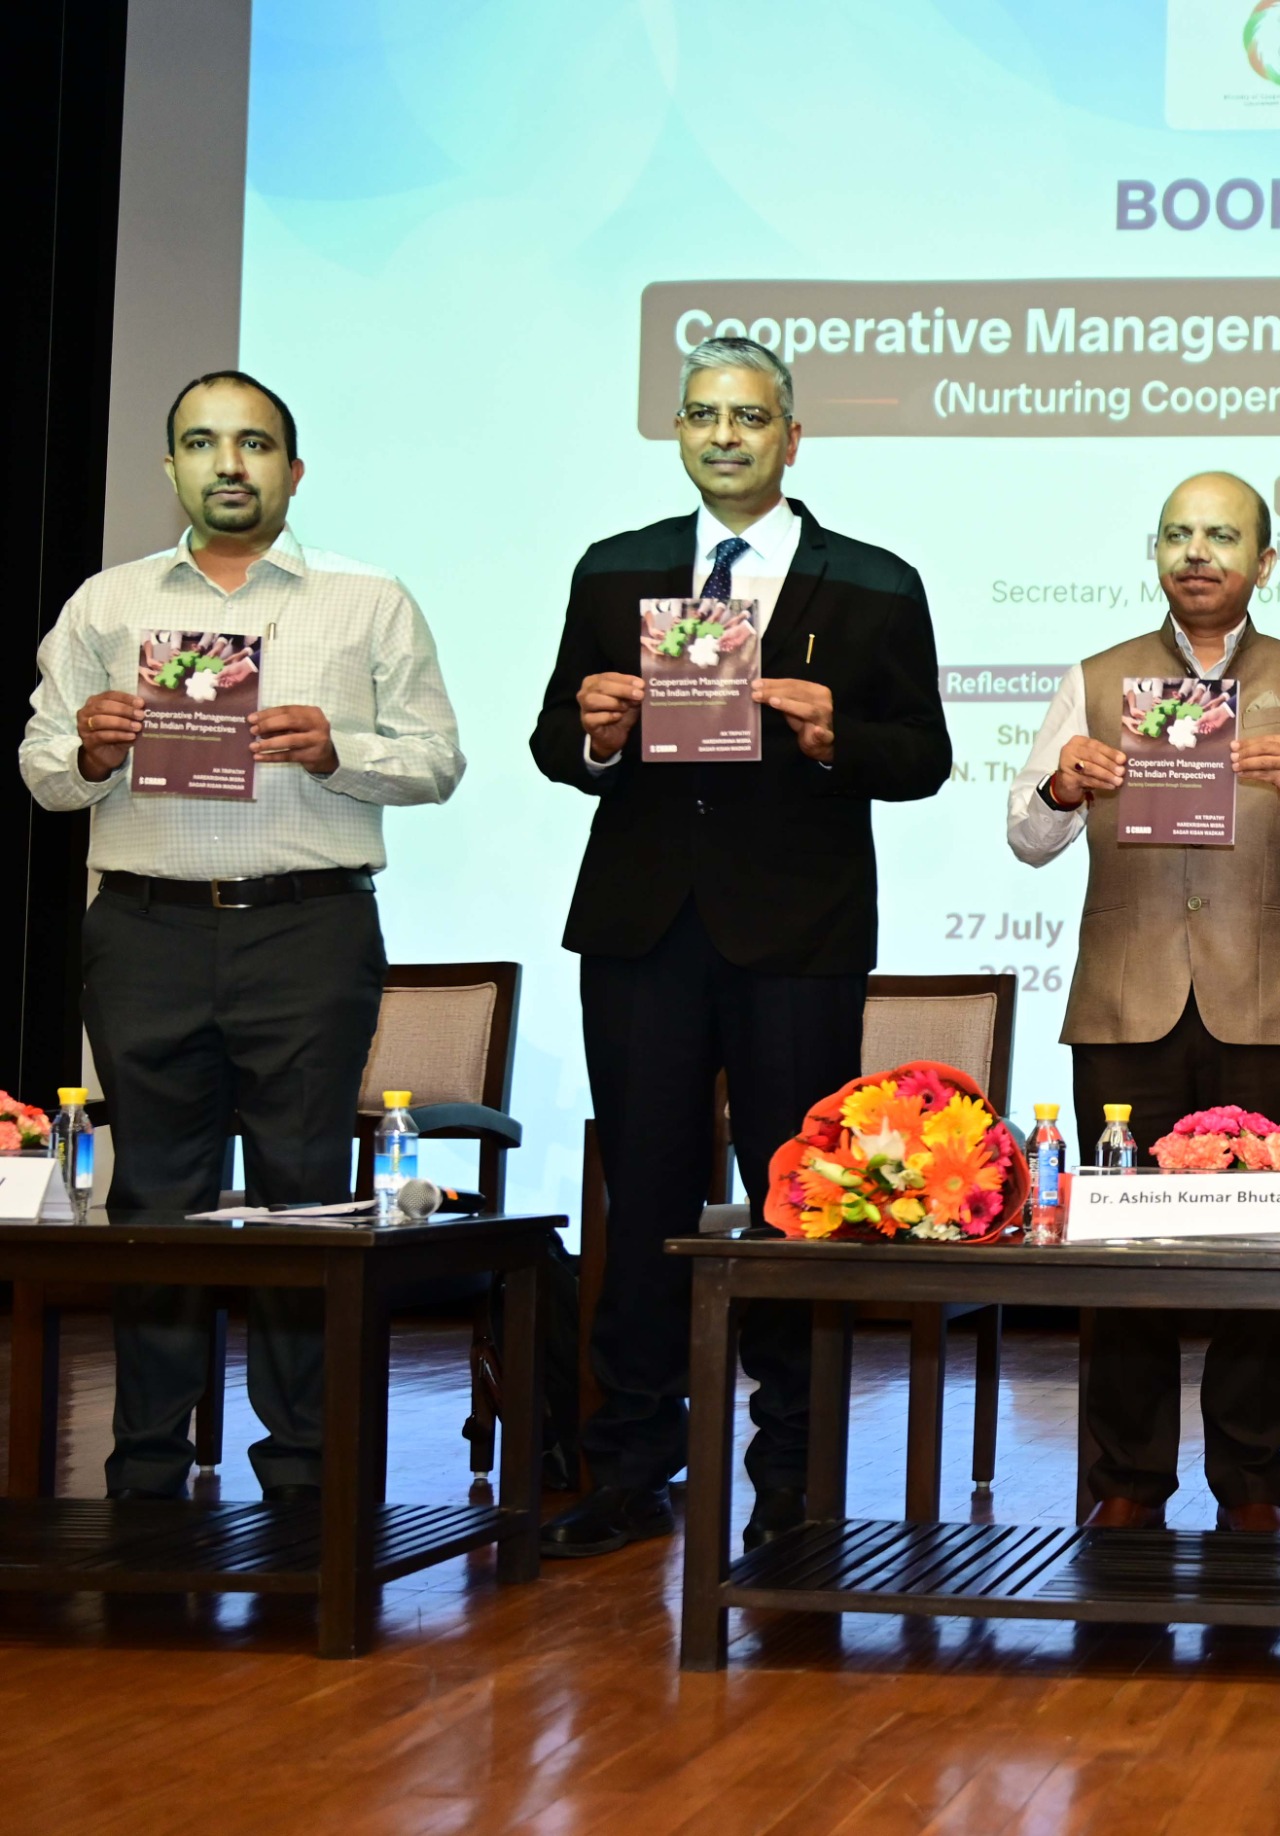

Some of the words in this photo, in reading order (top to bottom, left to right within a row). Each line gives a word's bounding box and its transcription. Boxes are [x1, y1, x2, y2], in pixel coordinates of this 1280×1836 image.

[675, 306, 1011, 363] Cooperative
[934, 379, 1129, 419] (Nurturing
[992, 579, 1128, 608] Secretary,
[649, 678, 697, 687] Cooperative
[699, 677, 748, 687] Management
[650, 689, 665, 697] The
[667, 689, 690, 697] Indian
[692, 688, 739, 698] Perspectives
[144, 709, 192, 720] Cooperative
[194, 712, 245, 723] Management
[144, 721, 159, 729] The
[160, 722, 184, 730] Indian
[186, 722, 236, 733] Perspectives
[1128, 758, 1174, 768] Cooperative
[1177, 759, 1224, 770] Management
[1128, 770, 1143, 778] The
[1145, 770, 1166, 778] Indian
[1169, 771, 1215, 780] Perspectives
[945, 912, 986, 940] 27
[994, 911, 1064, 949] July
[1089, 1192, 1114, 1205] Dr.
[1119, 1190, 1172, 1204] Ashish
[1178, 1191, 1232, 1204] Kumar
